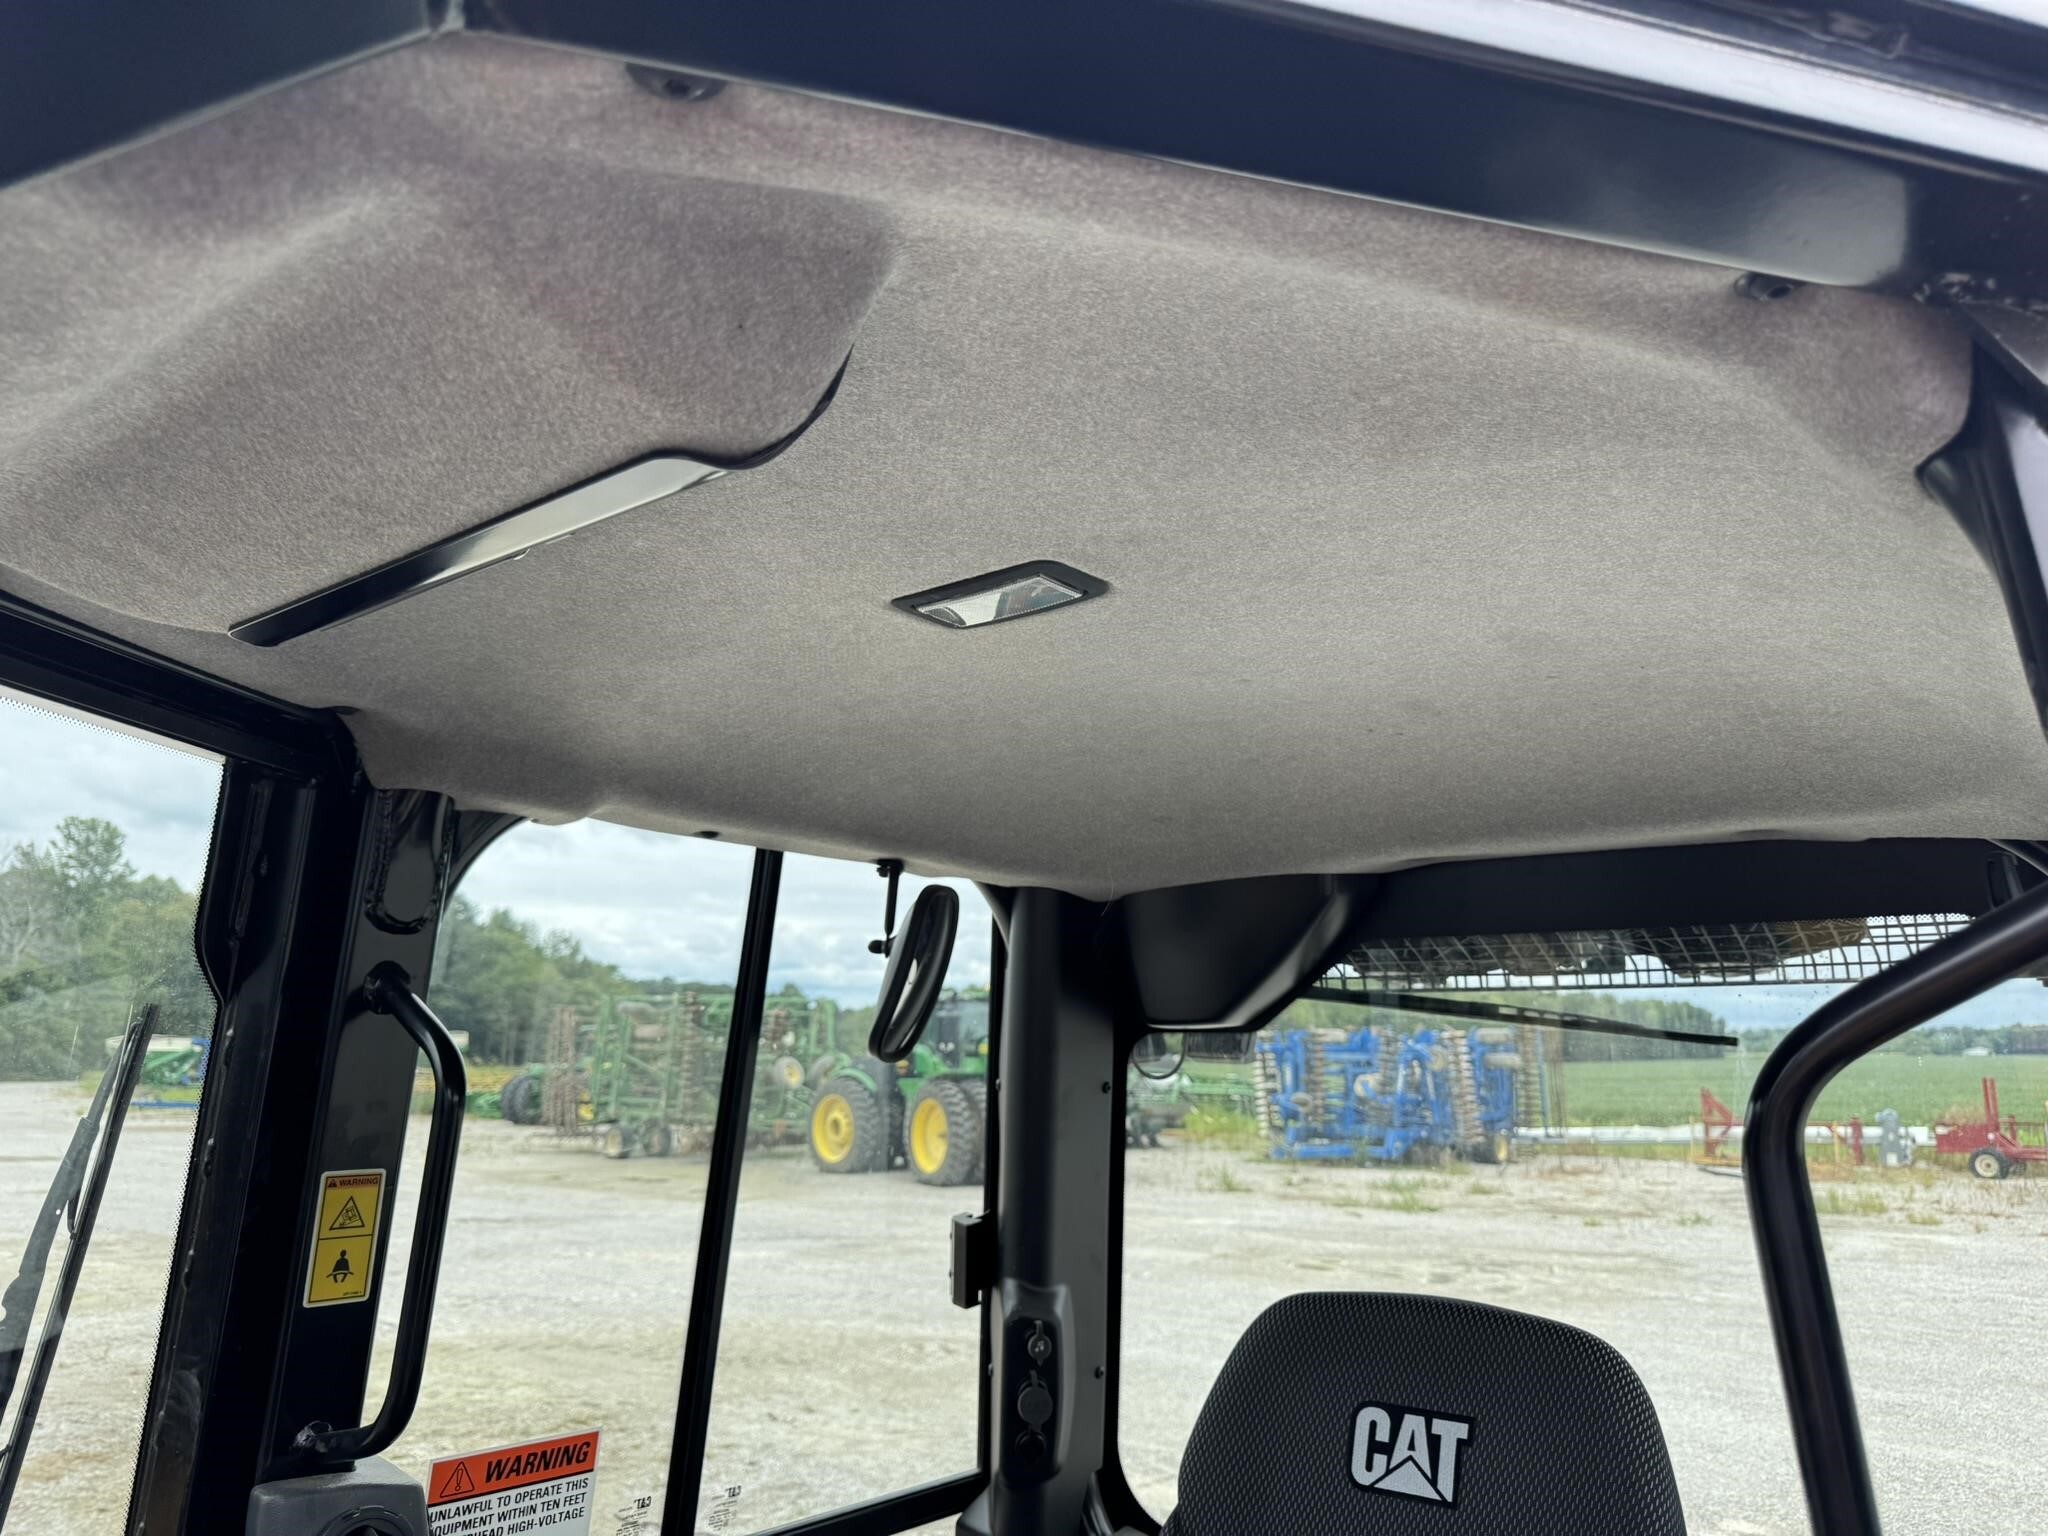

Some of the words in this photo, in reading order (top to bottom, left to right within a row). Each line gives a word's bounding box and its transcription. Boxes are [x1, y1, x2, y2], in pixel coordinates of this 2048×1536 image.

[339, 1177, 379, 1186] WARNING
[484, 1441, 591, 1483] WARNING
[1351, 1406, 1469, 1502] CAT
[430, 1499, 493, 1523] UNLAWFUL
[497, 1495, 511, 1508] TO
[515, 1484, 563, 1504] OPERATE
[566, 1478, 589, 1493] THIS
[432, 1514, 494, 1536] QUIPMENT
[498, 1503, 538, 1522] WITHIN
[540, 1498, 561, 1513] TEN
[563, 1492, 587, 1507] FEET
[507, 1506, 585, 1535] HIGH-VOLTAGE
